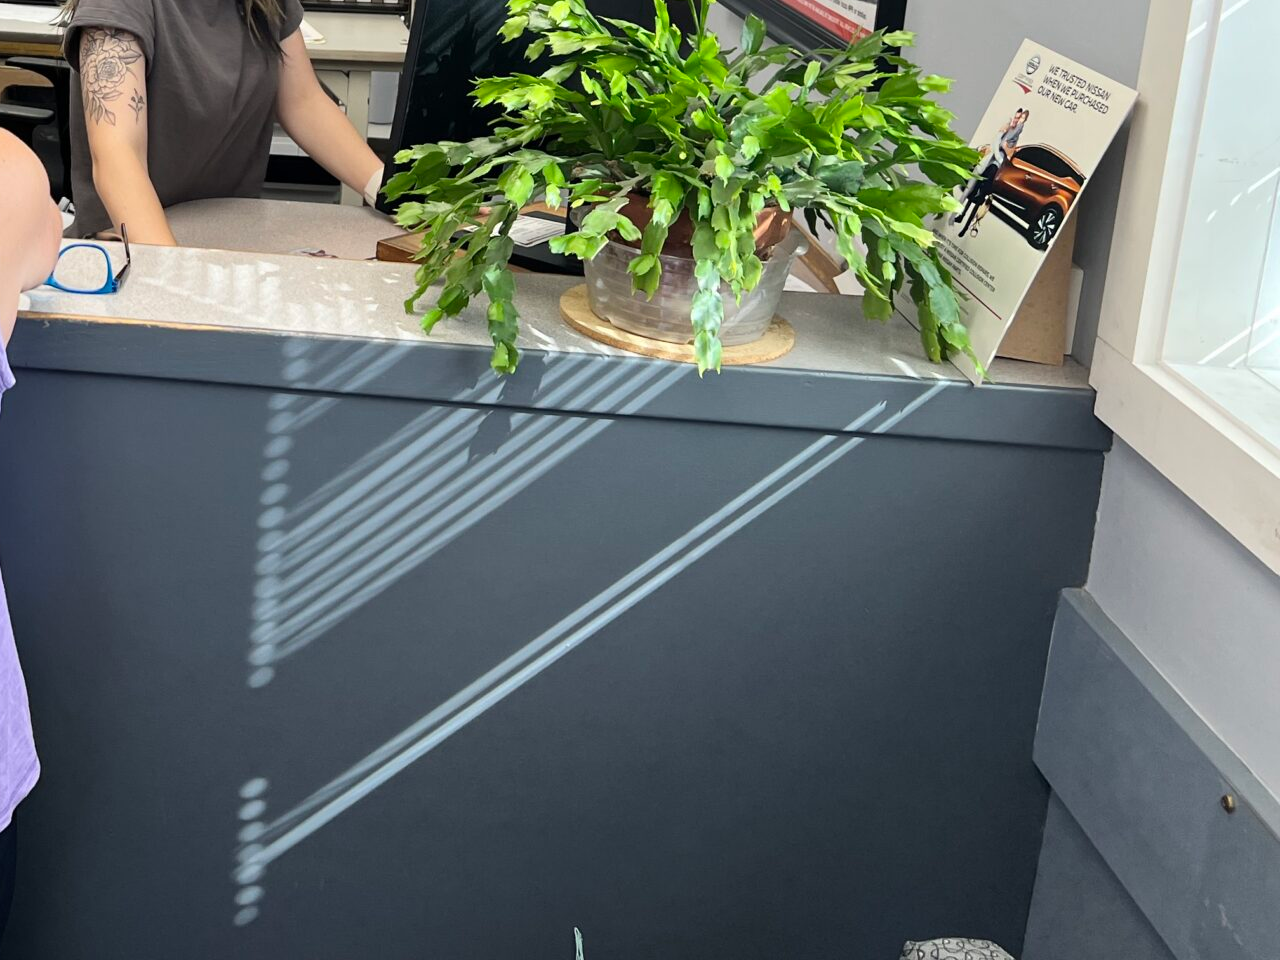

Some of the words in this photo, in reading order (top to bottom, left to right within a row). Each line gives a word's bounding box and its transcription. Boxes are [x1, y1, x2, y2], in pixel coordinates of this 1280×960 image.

[1037, 85, 1051, 99] OUR
[1050, 92, 1065, 106] NEW
[1043, 74, 1061, 91] WHEN
[1060, 83, 1072, 96] WE
[1071, 89, 1109, 115] PURCHASED
[1048, 64, 1060, 75] WE
[1060, 69, 1087, 89] TRUSTED
[1086, 83, 1111, 102] NISSAN
